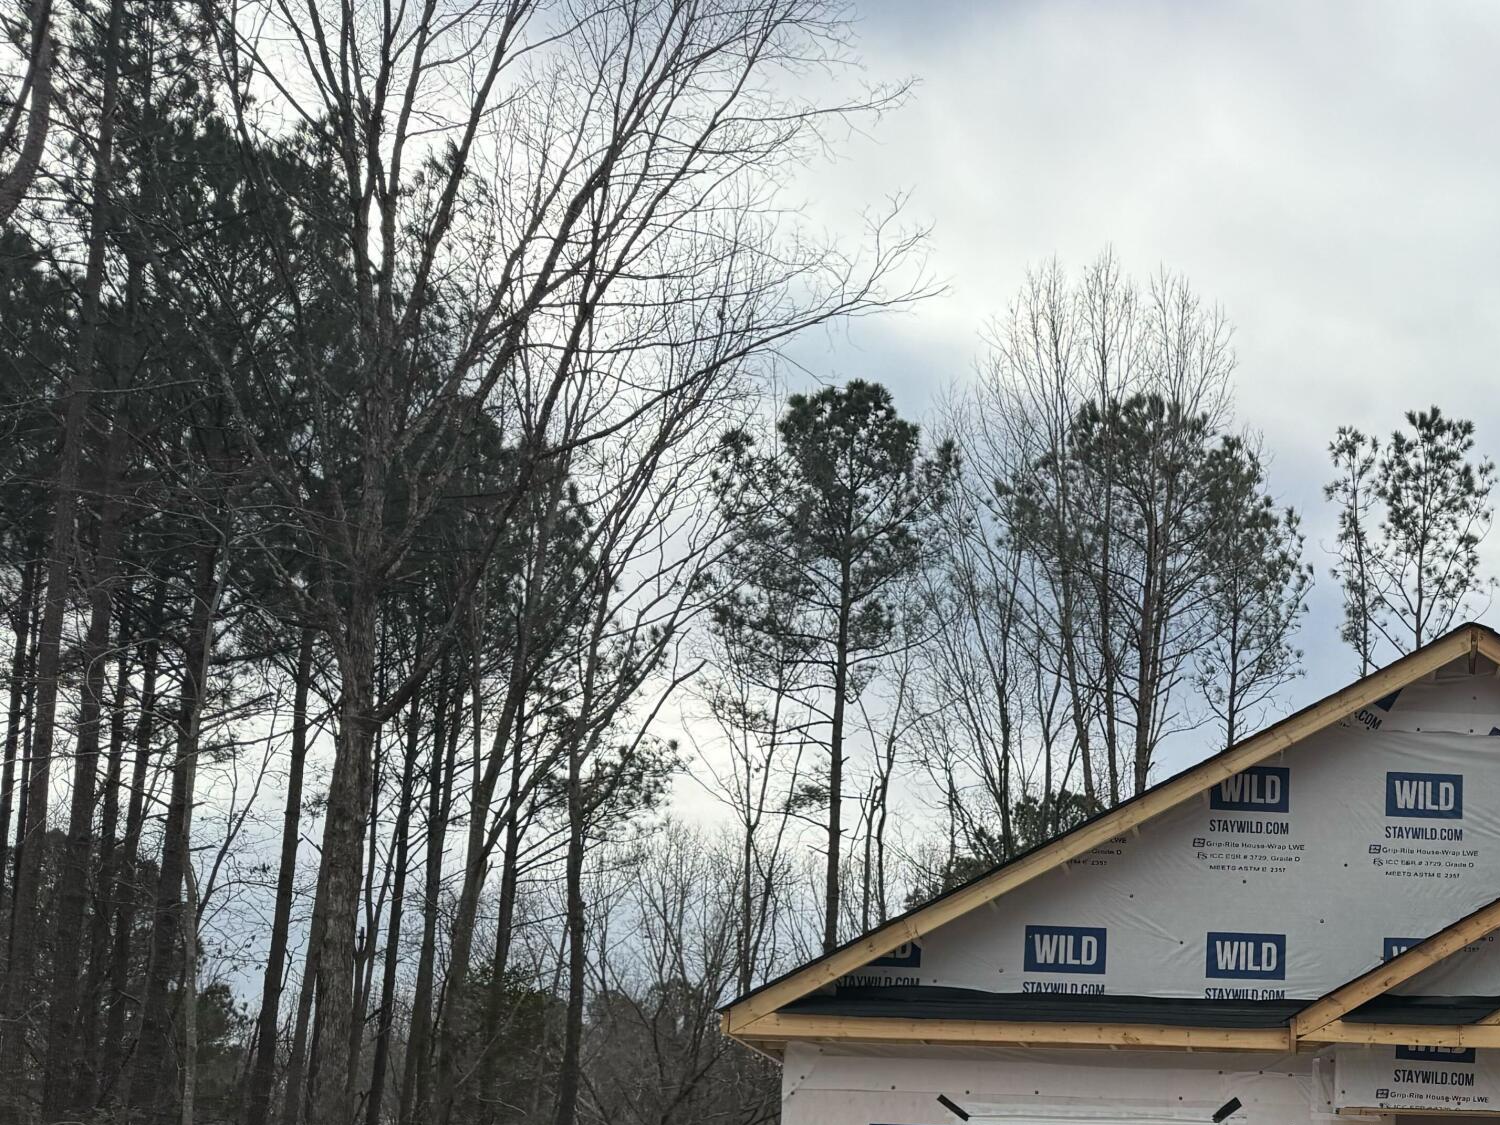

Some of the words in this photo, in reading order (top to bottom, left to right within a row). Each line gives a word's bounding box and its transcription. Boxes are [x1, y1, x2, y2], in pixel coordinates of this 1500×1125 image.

[1220, 774, 1281, 804] WILD
[1394, 780, 1455, 811] WILD
[1210, 819, 1288, 834] STAYWILD.COM
[1385, 826, 1462, 840] STAYWILD.COM
[1034, 933, 1097, 966] WILD
[1215, 940, 1277, 972] WILD
[1022, 981, 1105, 996] STAYWILD.COM
[1205, 988, 1285, 1000] STAYWILD.COM
[1394, 1069, 1474, 1086] STAYWILD.COM
